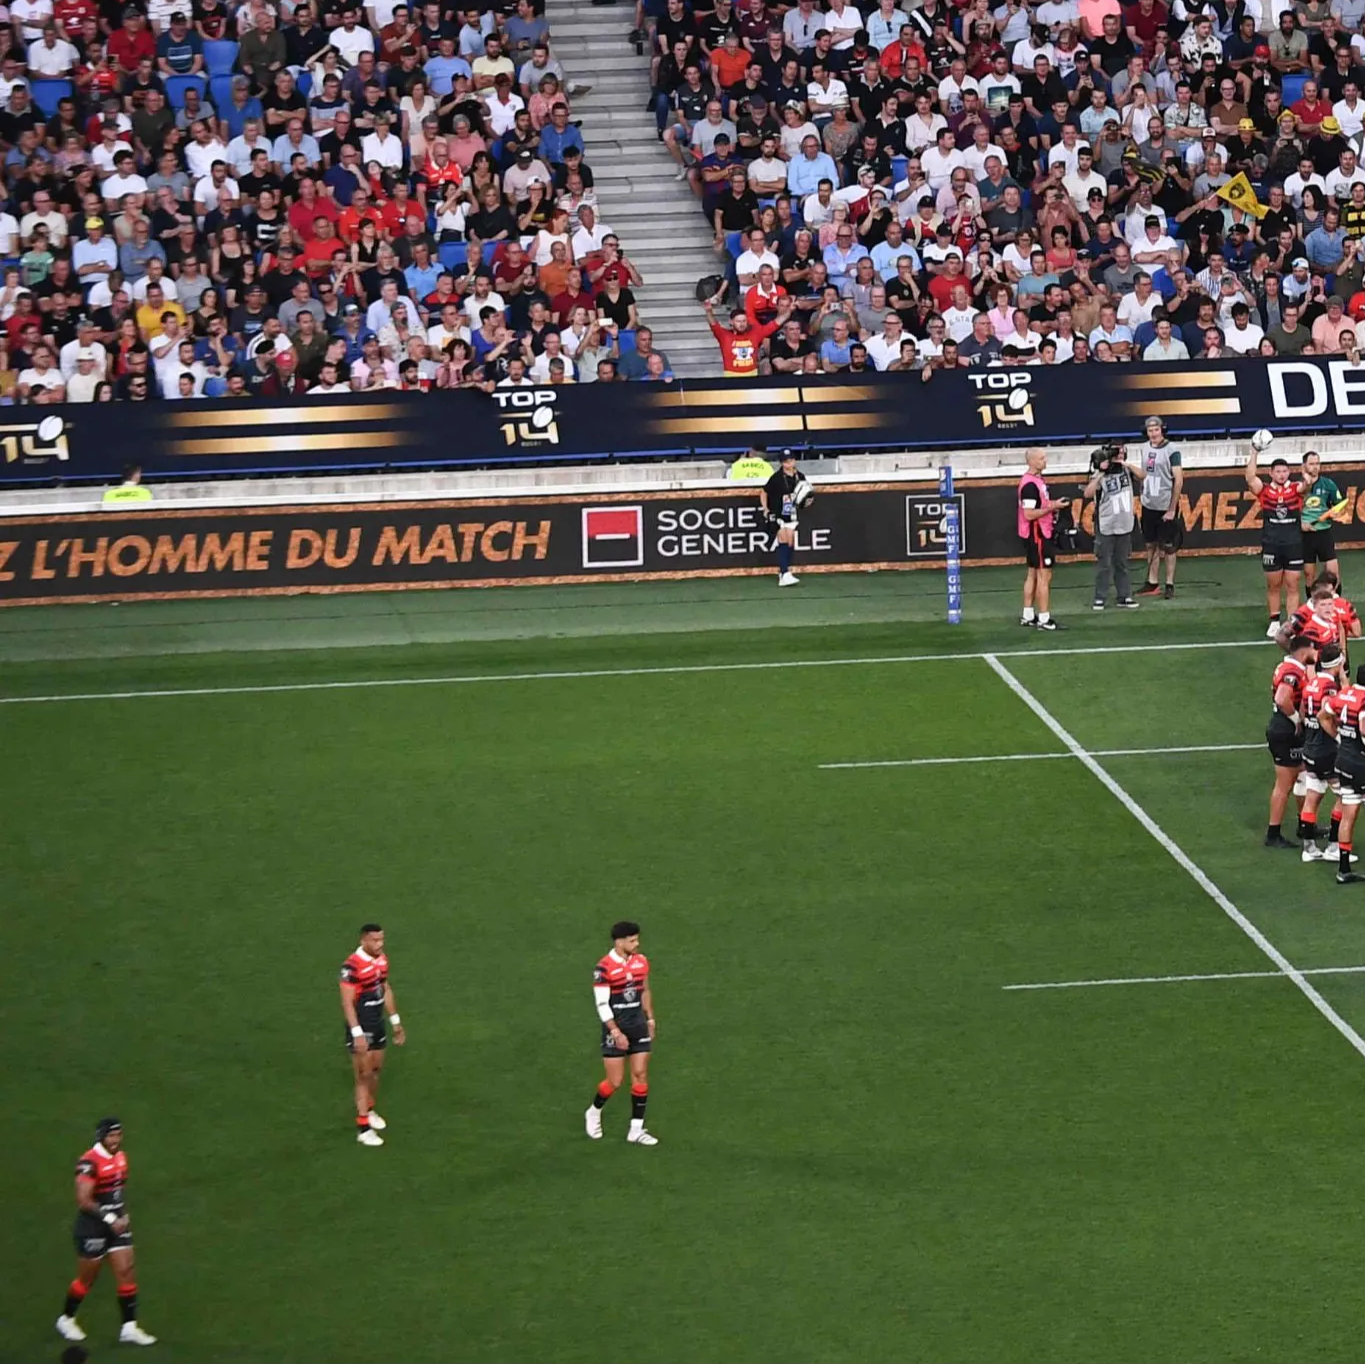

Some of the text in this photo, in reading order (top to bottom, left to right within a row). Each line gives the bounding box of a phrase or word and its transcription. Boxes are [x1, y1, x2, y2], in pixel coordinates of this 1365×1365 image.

[968, 371, 1031, 389] TOP
[491, 390, 558, 408] TOP
[977, 402, 1035, 427] 14
[500, 421, 559, 445] 14
[657, 506, 767, 531] SOCIE
[31, 530, 275, 580] L'HOMME
[286, 525, 363, 570] DU
[371, 520, 551, 566] MATCH
